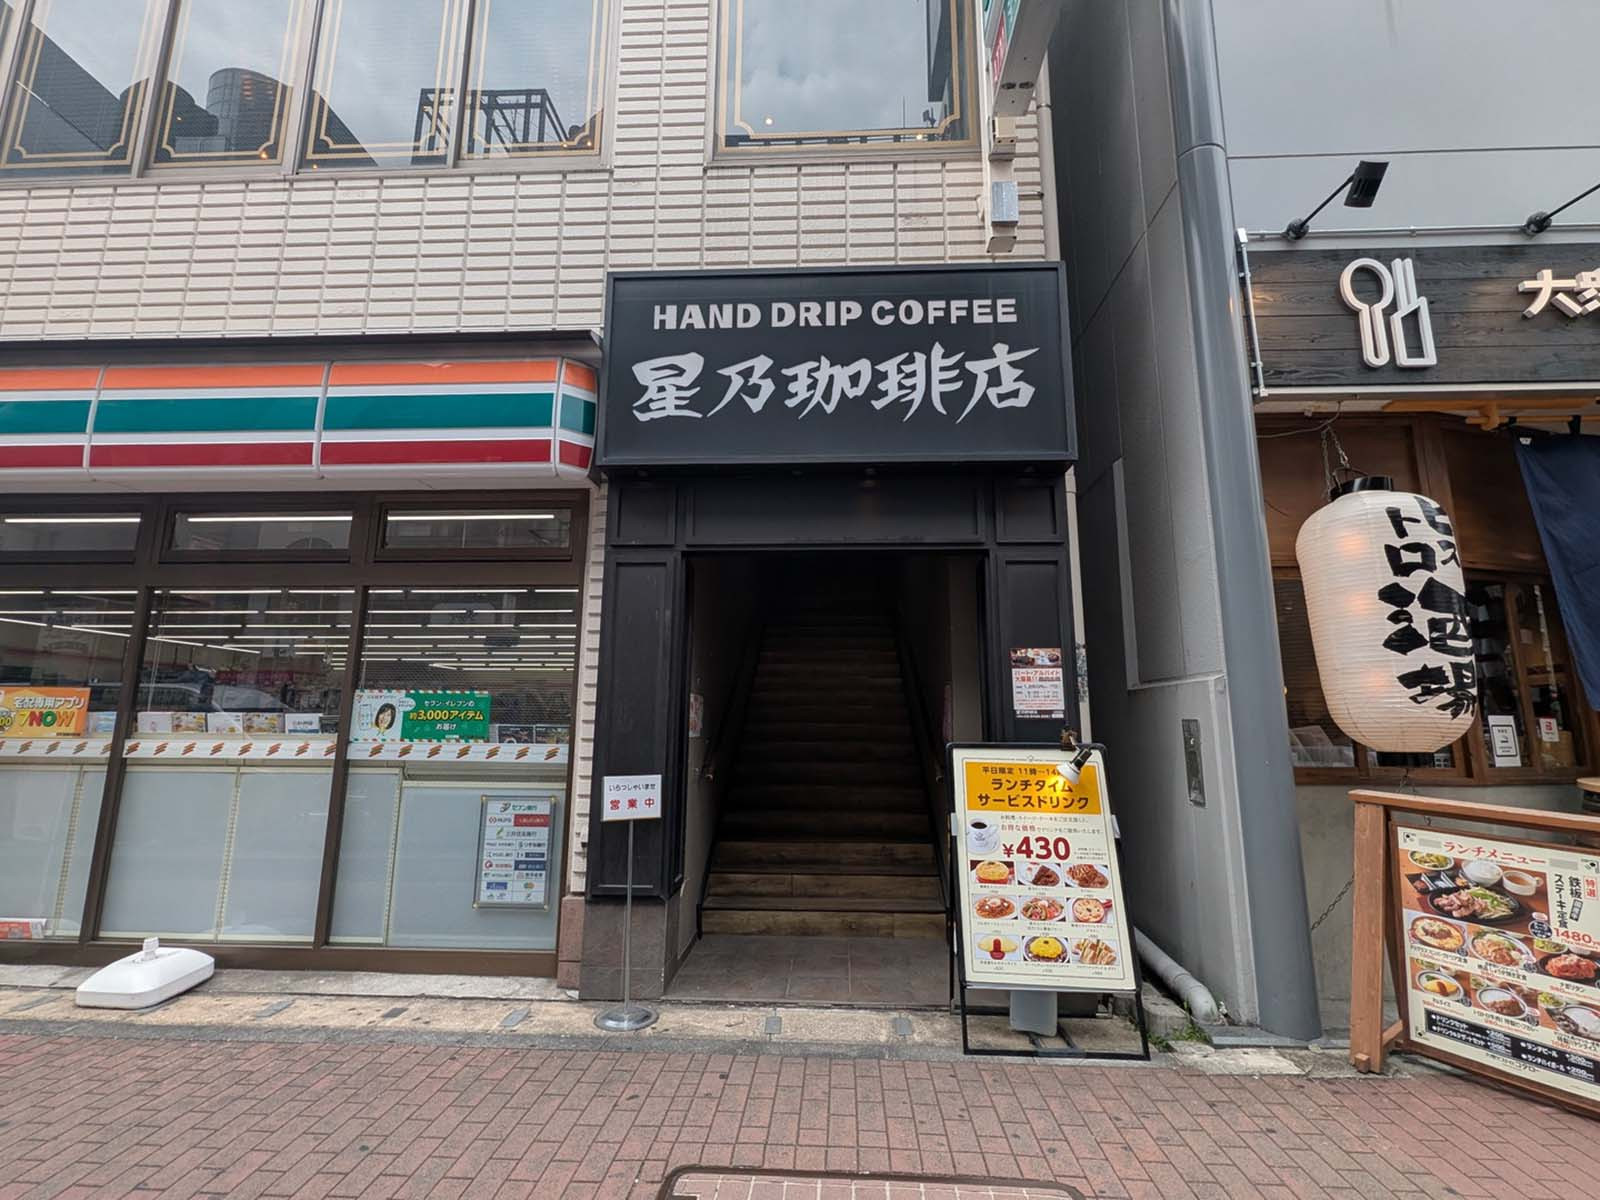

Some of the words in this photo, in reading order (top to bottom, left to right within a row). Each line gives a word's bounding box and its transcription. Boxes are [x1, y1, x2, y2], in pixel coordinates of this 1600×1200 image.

[653, 304, 761, 330] HAND
[770, 301, 862, 328] DRIP
[871, 298, 1018, 325] COFFEE
[631, 341, 1041, 424] 星乃珈琲店
[18, 710, 75, 727] 7NOW
[409, 710, 484, 720] 約3,000アイテム
[982, 766, 1015, 775] 平日限定
[991, 778, 1073, 793] ランチタイム
[977, 794, 1090, 810] サービスドリンク
[1002, 836, 1071, 861] ¥430
[1443, 841, 1546, 865] ランチメニュー
[1568, 876, 1583, 900] 鉄板
